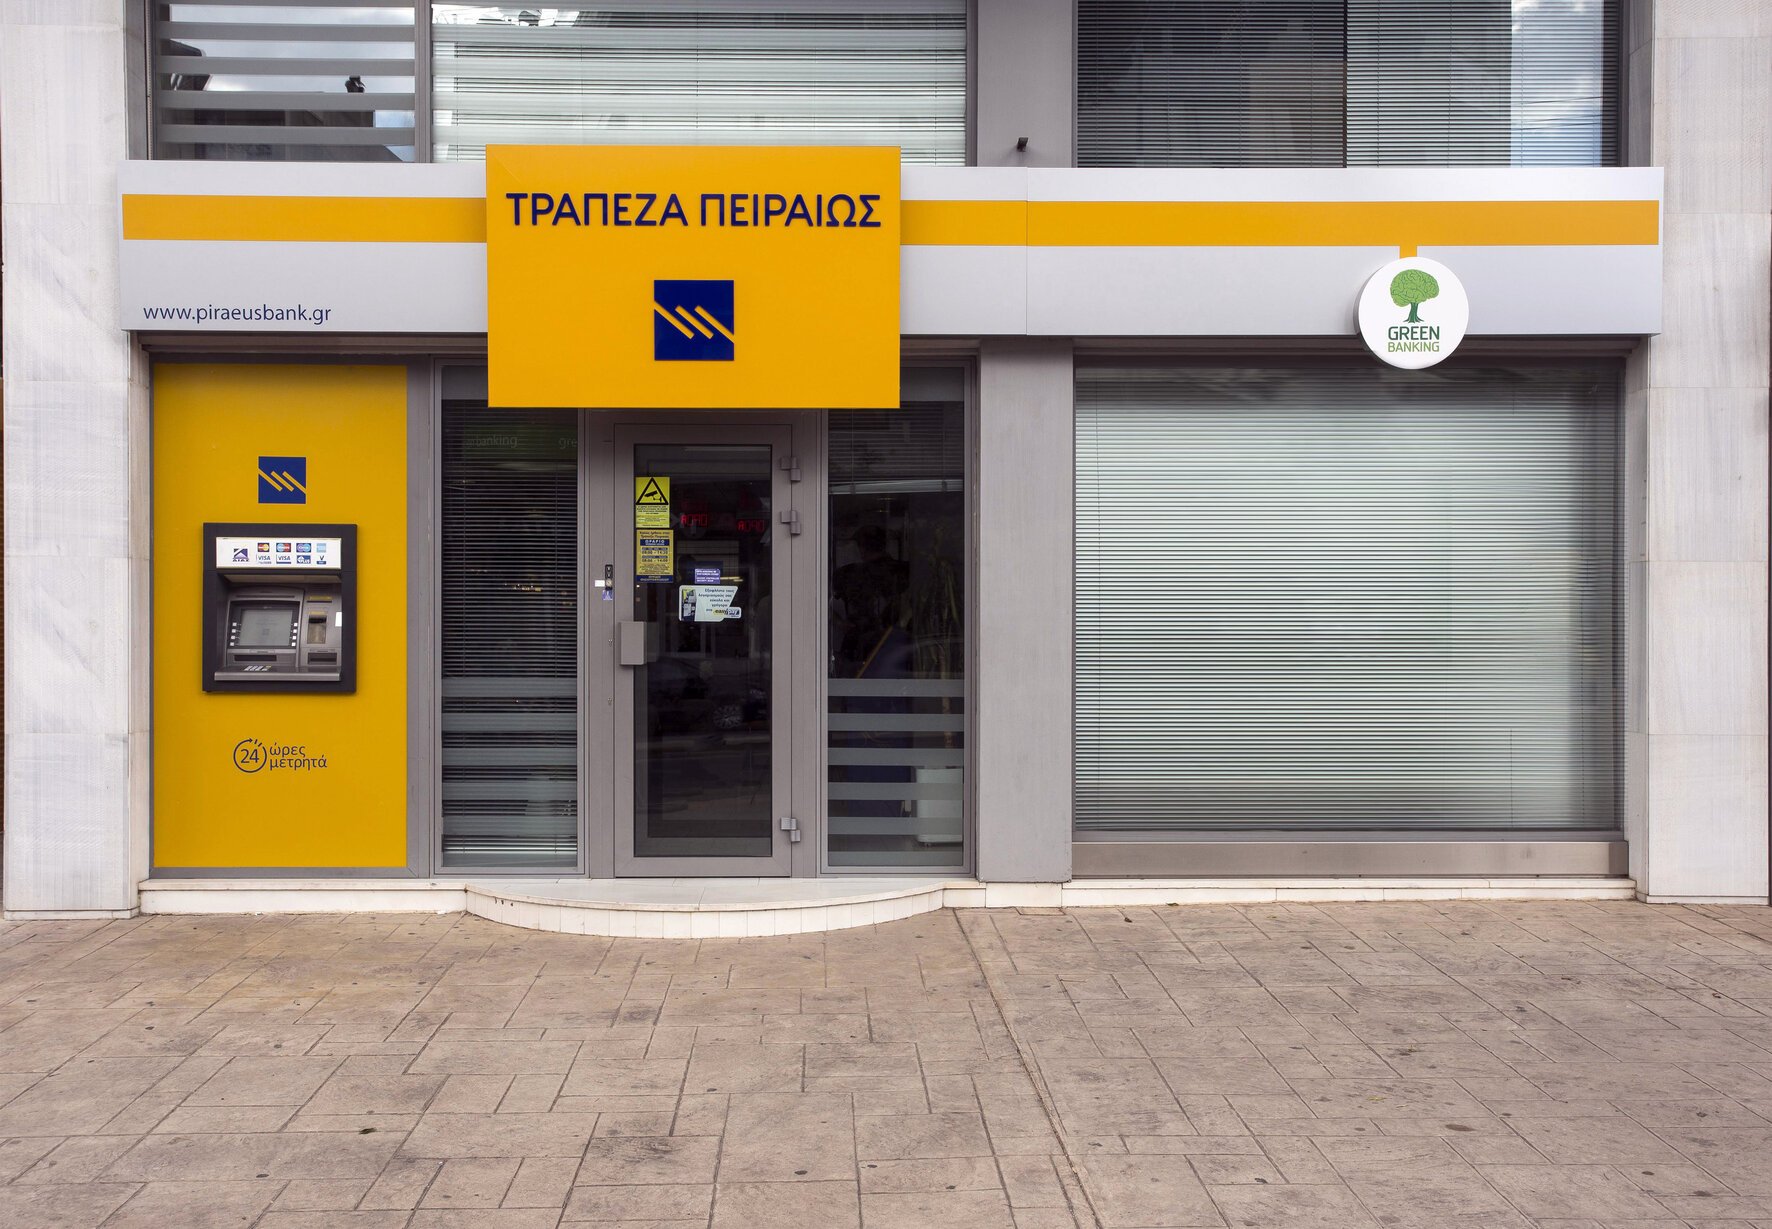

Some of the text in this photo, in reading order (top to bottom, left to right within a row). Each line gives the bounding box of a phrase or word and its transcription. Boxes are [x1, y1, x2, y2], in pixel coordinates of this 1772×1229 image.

[506, 194, 881, 227] ΤΡΑΠΕΖΑ ΠΕΙΡΑΙΩΣ
[143, 304, 332, 325] www.piraeusbank.gr
[1388, 326, 1440, 340] GREEN
[1388, 342, 1440, 352] BANKING
[240, 742, 306, 764] 24 ώρες
[269, 754, 327, 771] μετρητά
